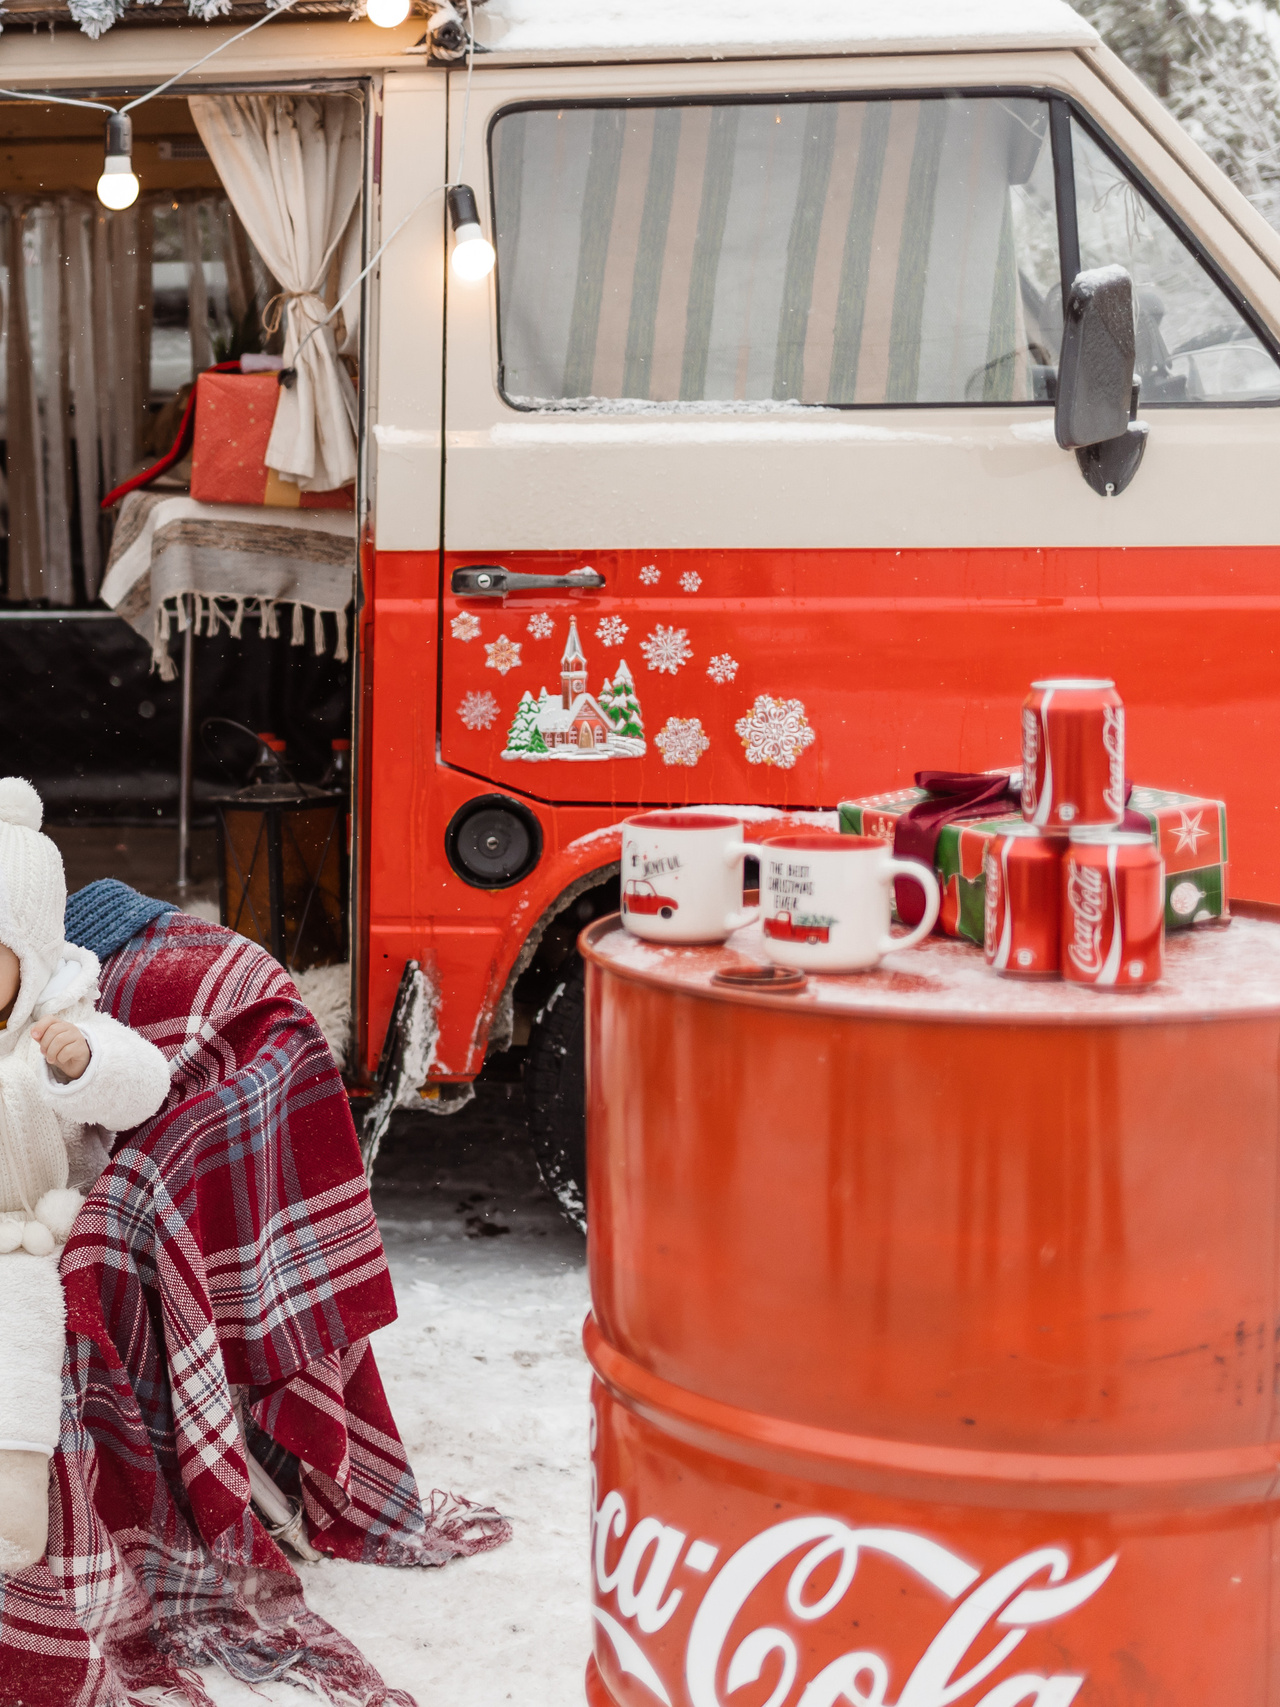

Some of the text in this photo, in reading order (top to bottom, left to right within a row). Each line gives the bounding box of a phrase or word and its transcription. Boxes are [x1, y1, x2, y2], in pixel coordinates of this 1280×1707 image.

[770, 861, 810, 878] THE BEST
[768, 876, 813, 896] CHRISTMAS
[1067, 858, 1103, 974] Coca-Cola
